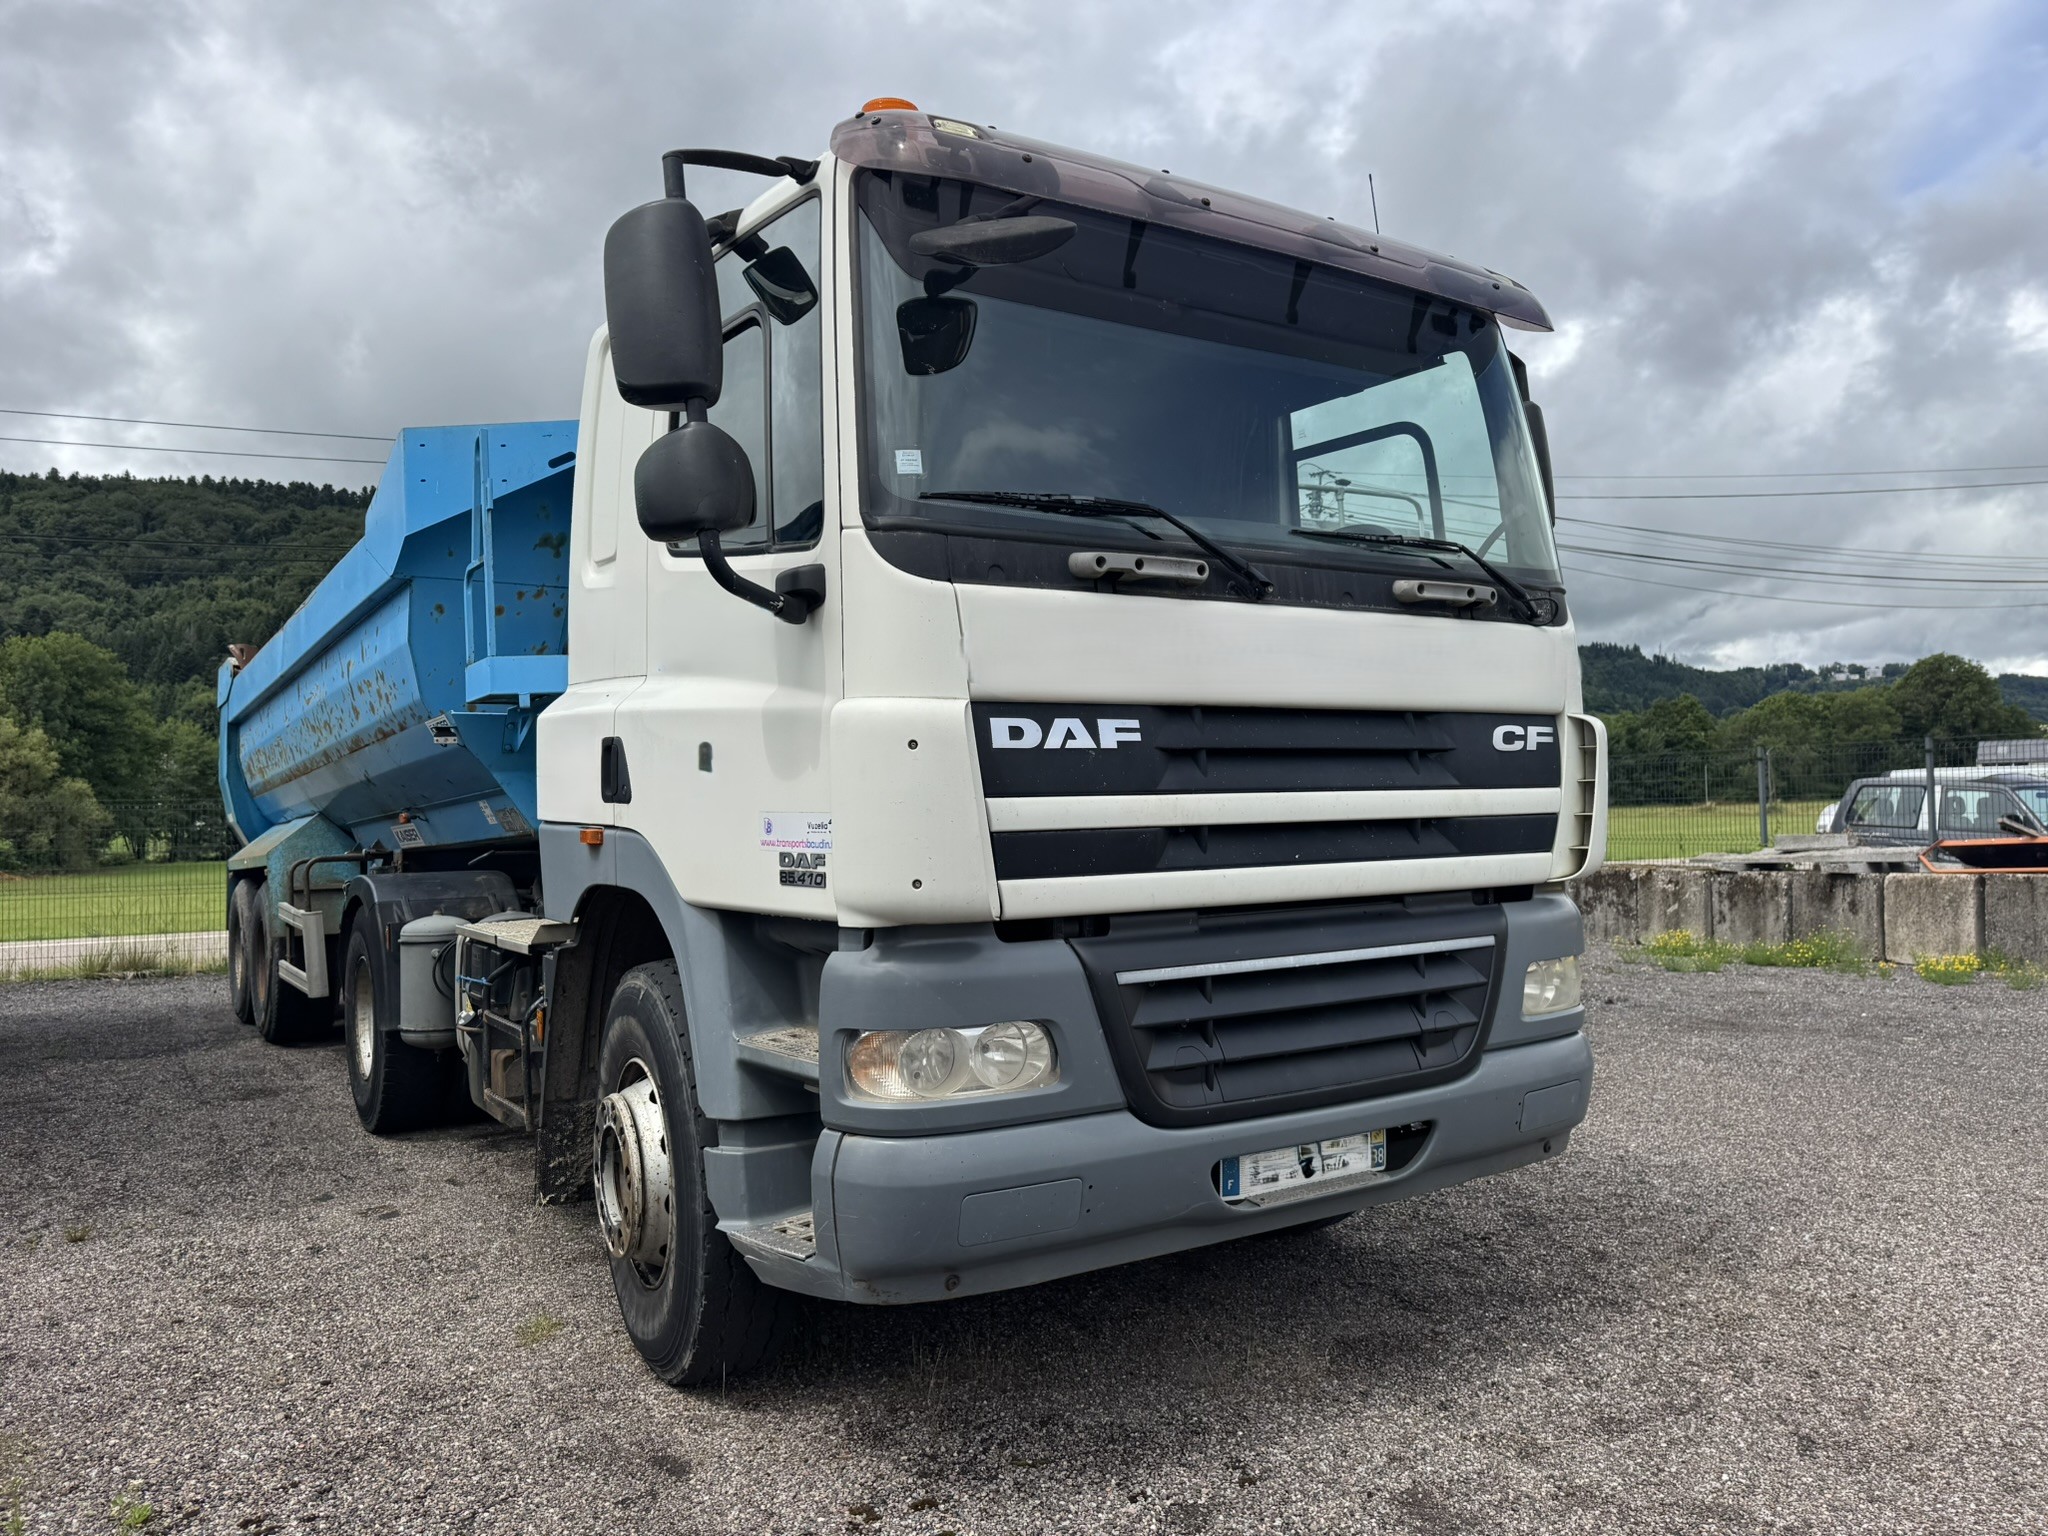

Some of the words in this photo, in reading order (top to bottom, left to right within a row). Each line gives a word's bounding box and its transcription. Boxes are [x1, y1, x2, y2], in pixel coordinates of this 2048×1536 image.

[989, 717, 1142, 749] DAF
[1492, 724, 1554, 752] CF
[779, 851, 826, 869] DAF
[779, 870, 825, 886] 85.410
[1227, 1179, 1234, 1190] F
